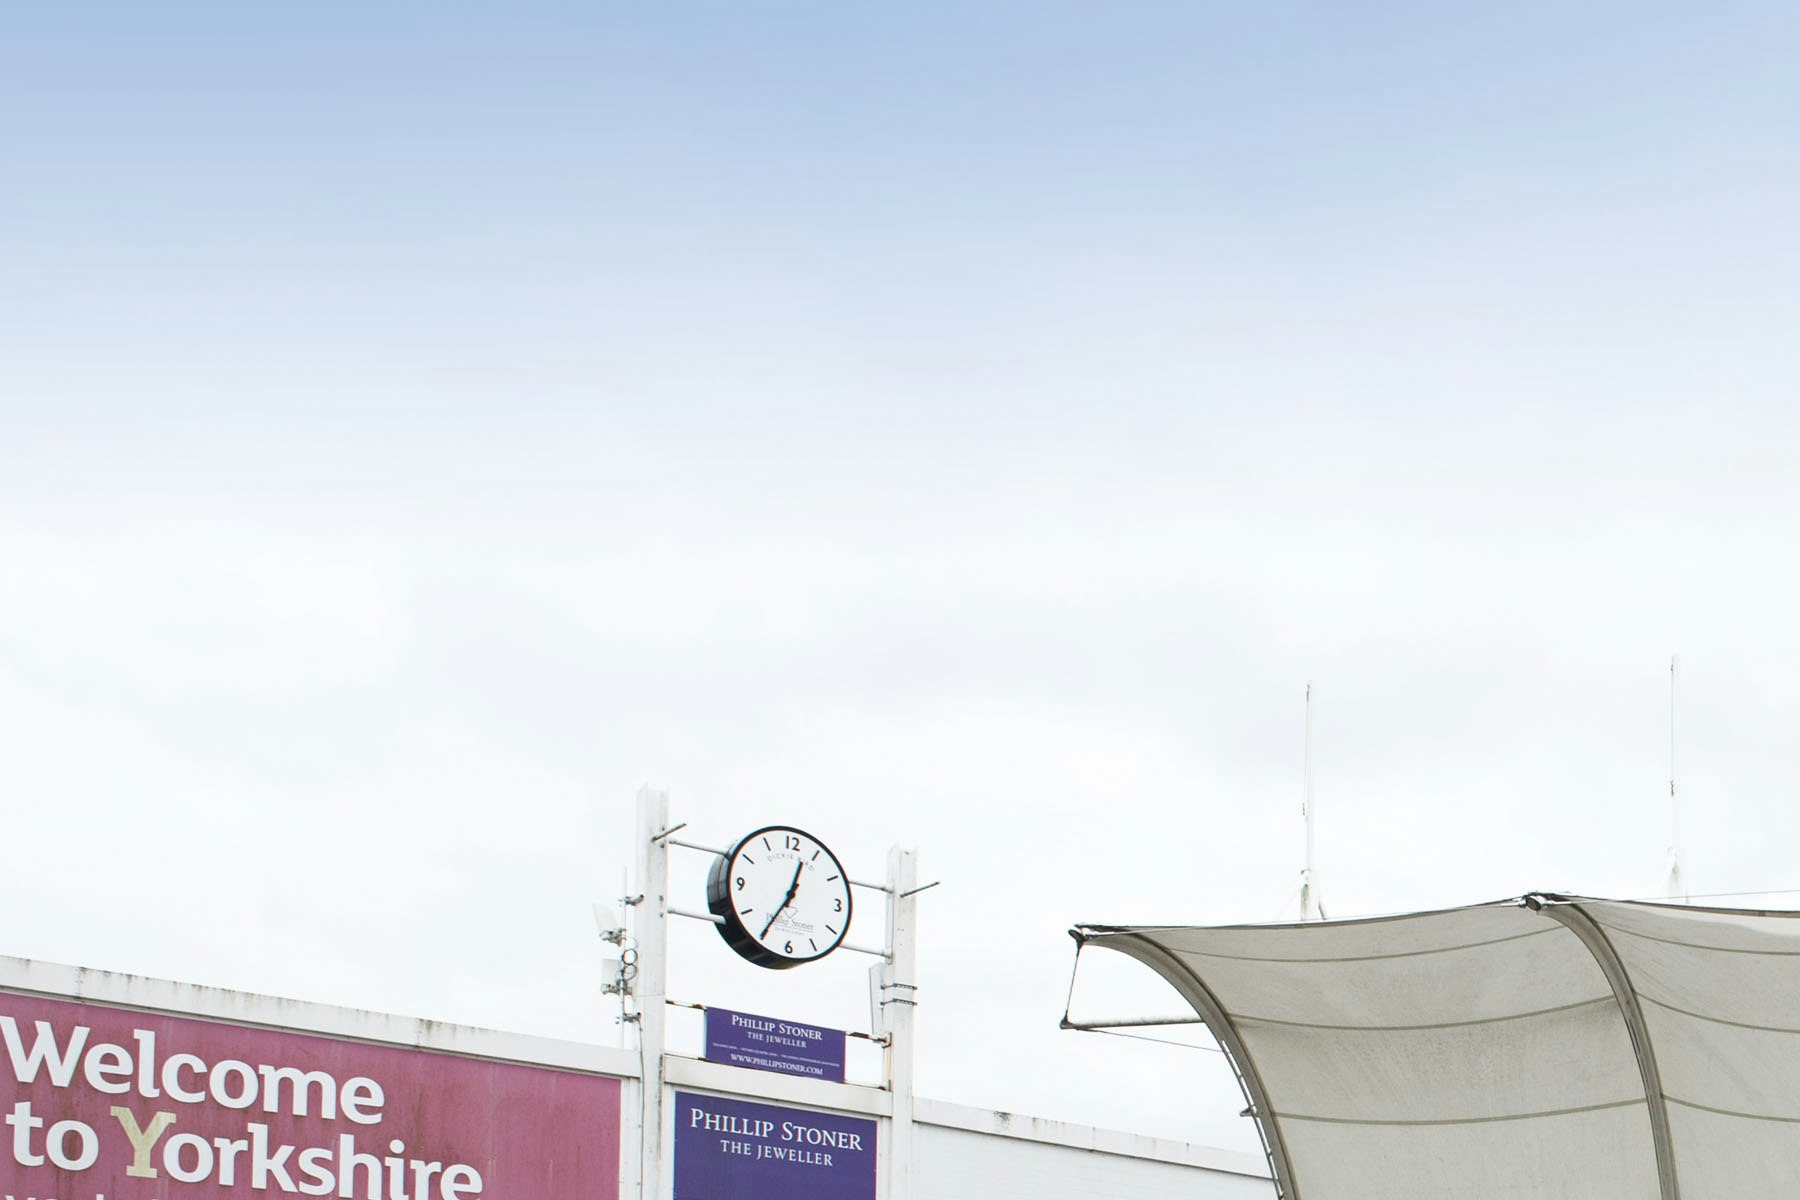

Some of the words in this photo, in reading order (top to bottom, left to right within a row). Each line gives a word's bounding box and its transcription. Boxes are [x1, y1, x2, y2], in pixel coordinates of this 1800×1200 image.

[786, 835, 801, 851] 12
[736, 877, 745, 891] 9
[834, 898, 842, 912] 3
[784, 940, 793, 954] 6
[731, 1014, 776, 1032] PHILLIP
[779, 1022, 823, 1041] STONER
[747, 1031, 763, 1041] THE
[766, 1035, 807, 1049] JEWELLER
[0, 1016, 386, 1126] Welcome
[6, 1101, 99, 1171] to
[690, 1108, 775, 1138] PHILLIP
[781, 1122, 863, 1151] STONER
[720, 1139, 752, 1155] THE
[756, 1145, 833, 1167] JEWELLER
